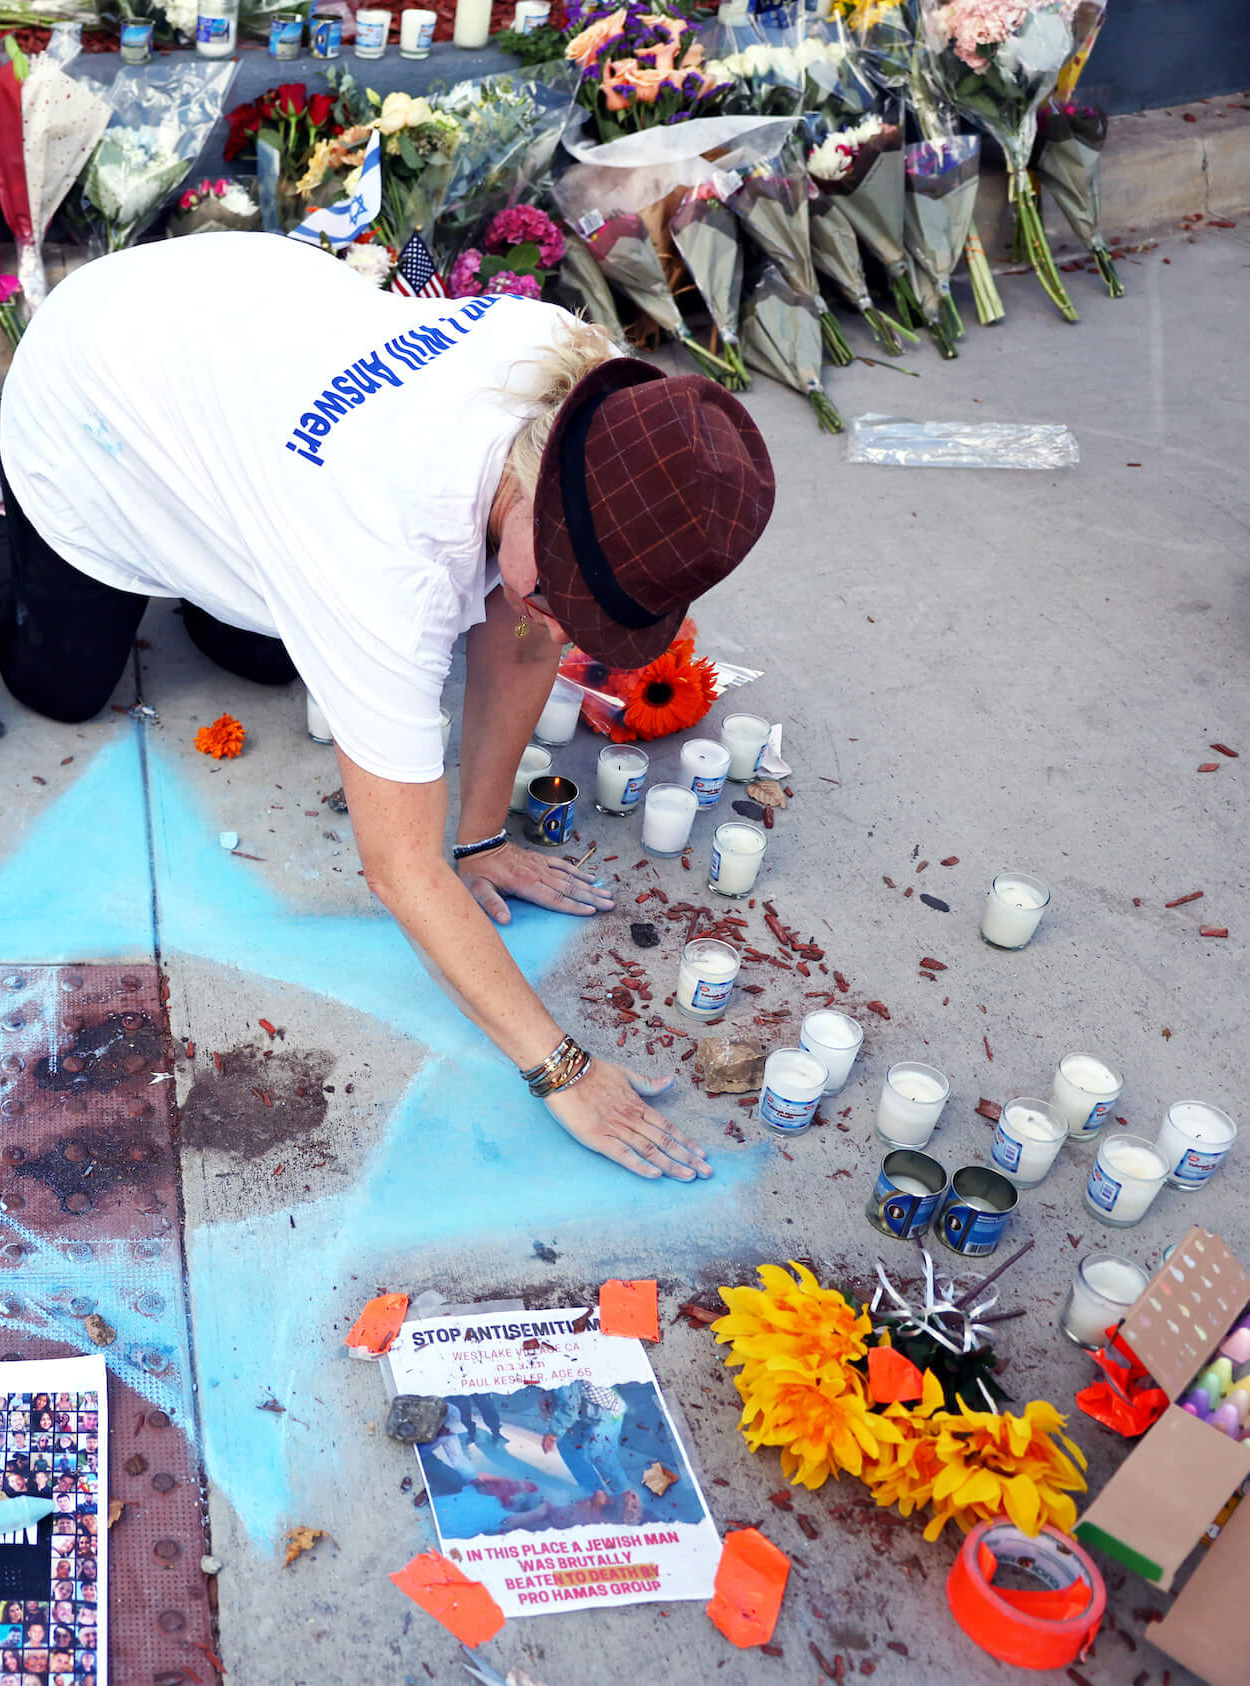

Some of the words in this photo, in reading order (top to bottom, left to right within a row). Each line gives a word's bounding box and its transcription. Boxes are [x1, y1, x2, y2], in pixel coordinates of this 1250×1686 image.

[385, 326, 458, 370] Will
[285, 350, 405, 467] Answer!
[412, 1328, 461, 1346] STOP
[463, 1318, 600, 1342] ANTISEMITIM
[453, 1349, 512, 1361] WESTLAKE
[461, 1378, 491, 1389] PAUL
[551, 1369, 573, 1380] AGE
[466, 1549, 483, 1562] IN
[485, 1546, 519, 1560] THIS
[522, 1540, 570, 1557] PLACE
[570, 1540, 583, 1553] A
[585, 1534, 642, 1552] JEWISH
[643, 1531, 680, 1546] MAN
[519, 1558, 556, 1573] WAS
[557, 1551, 632, 1569] BRUTALLY
[505, 1572, 565, 1590] BEATEN
[567, 1570, 587, 1584] TO
[590, 1567, 639, 1582] DEATH
[639, 1565, 660, 1579] BY
[517, 1590, 549, 1606] PRO
[551, 1584, 608, 1601] HAMAS
[609, 1580, 662, 1596] GROUP
